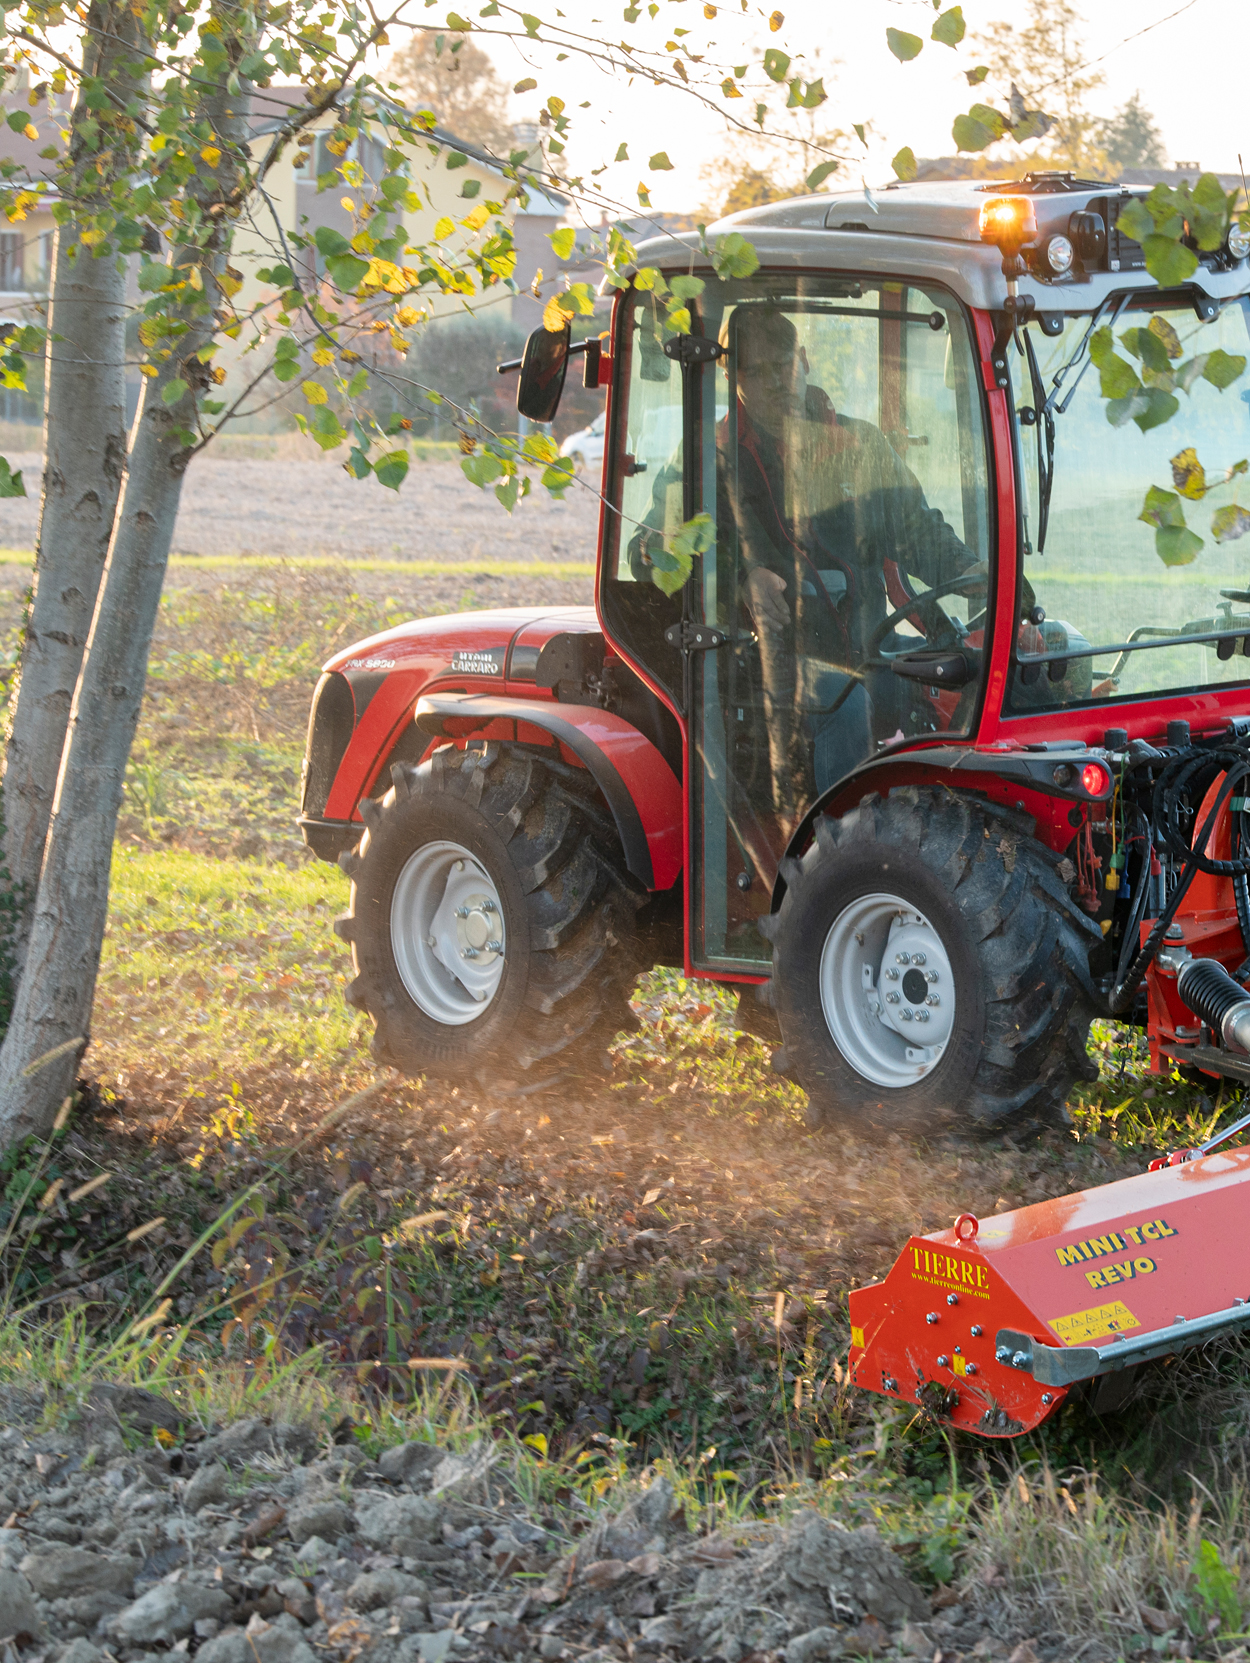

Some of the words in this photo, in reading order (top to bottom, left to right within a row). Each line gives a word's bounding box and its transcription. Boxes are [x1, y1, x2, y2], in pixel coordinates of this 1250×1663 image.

[451, 659, 499, 674] CARRARO
[1055, 1232, 1128, 1267] MINI
[1123, 1219, 1179, 1246] TCL
[909, 1246, 990, 1290] TIERRE
[1084, 1256, 1158, 1289] REVO
[911, 1272, 991, 1300] www.tierreonline.com
